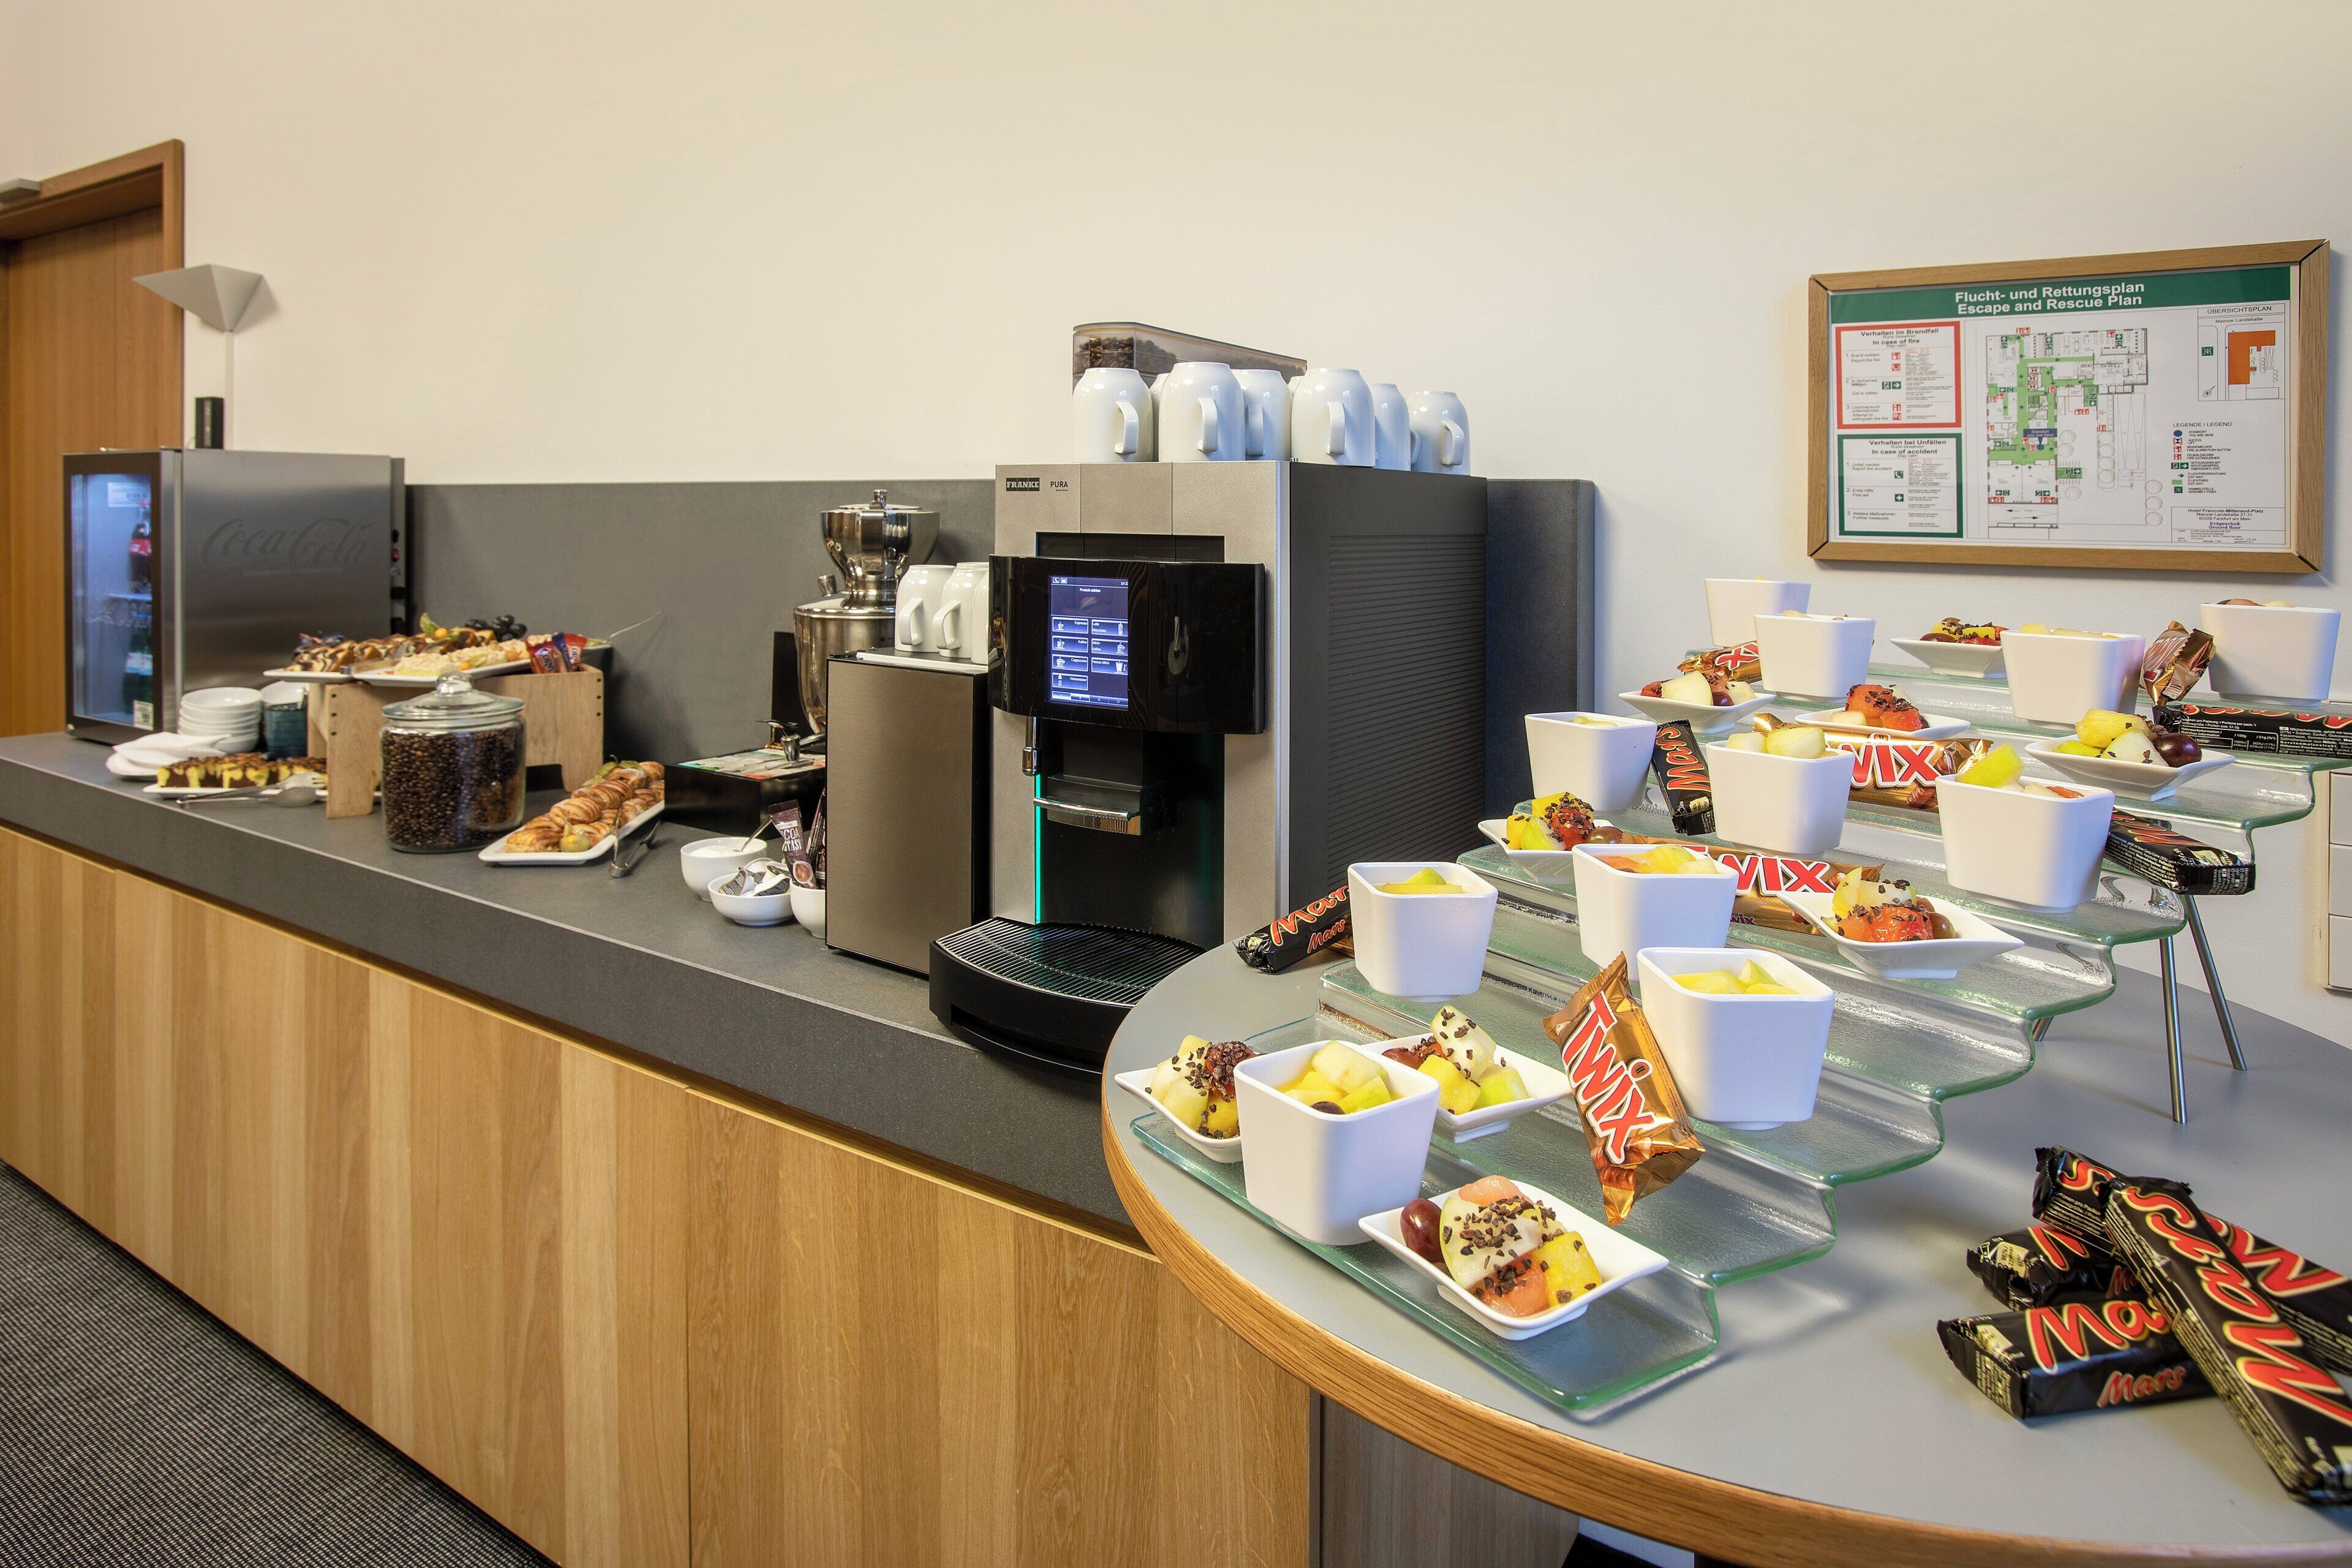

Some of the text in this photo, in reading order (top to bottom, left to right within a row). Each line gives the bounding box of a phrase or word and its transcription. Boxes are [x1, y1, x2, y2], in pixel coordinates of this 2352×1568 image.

[1955, 282, 2144, 303] Flucht- und Rettungsplan
[1958, 294, 2142, 315] Escape and Rescue Plan
[2207, 306, 2272, 314] ÜBERSICHTSPLAN
[1655, 727, 1712, 793] Mars
[1270, 884, 1350, 947] Mar
[1307, 919, 1346, 954] Mars
[2122, 1186, 2352, 1426] Mars
[2025, 1299, 2171, 1376] Ma
[2096, 1365, 2187, 1408] Mars
